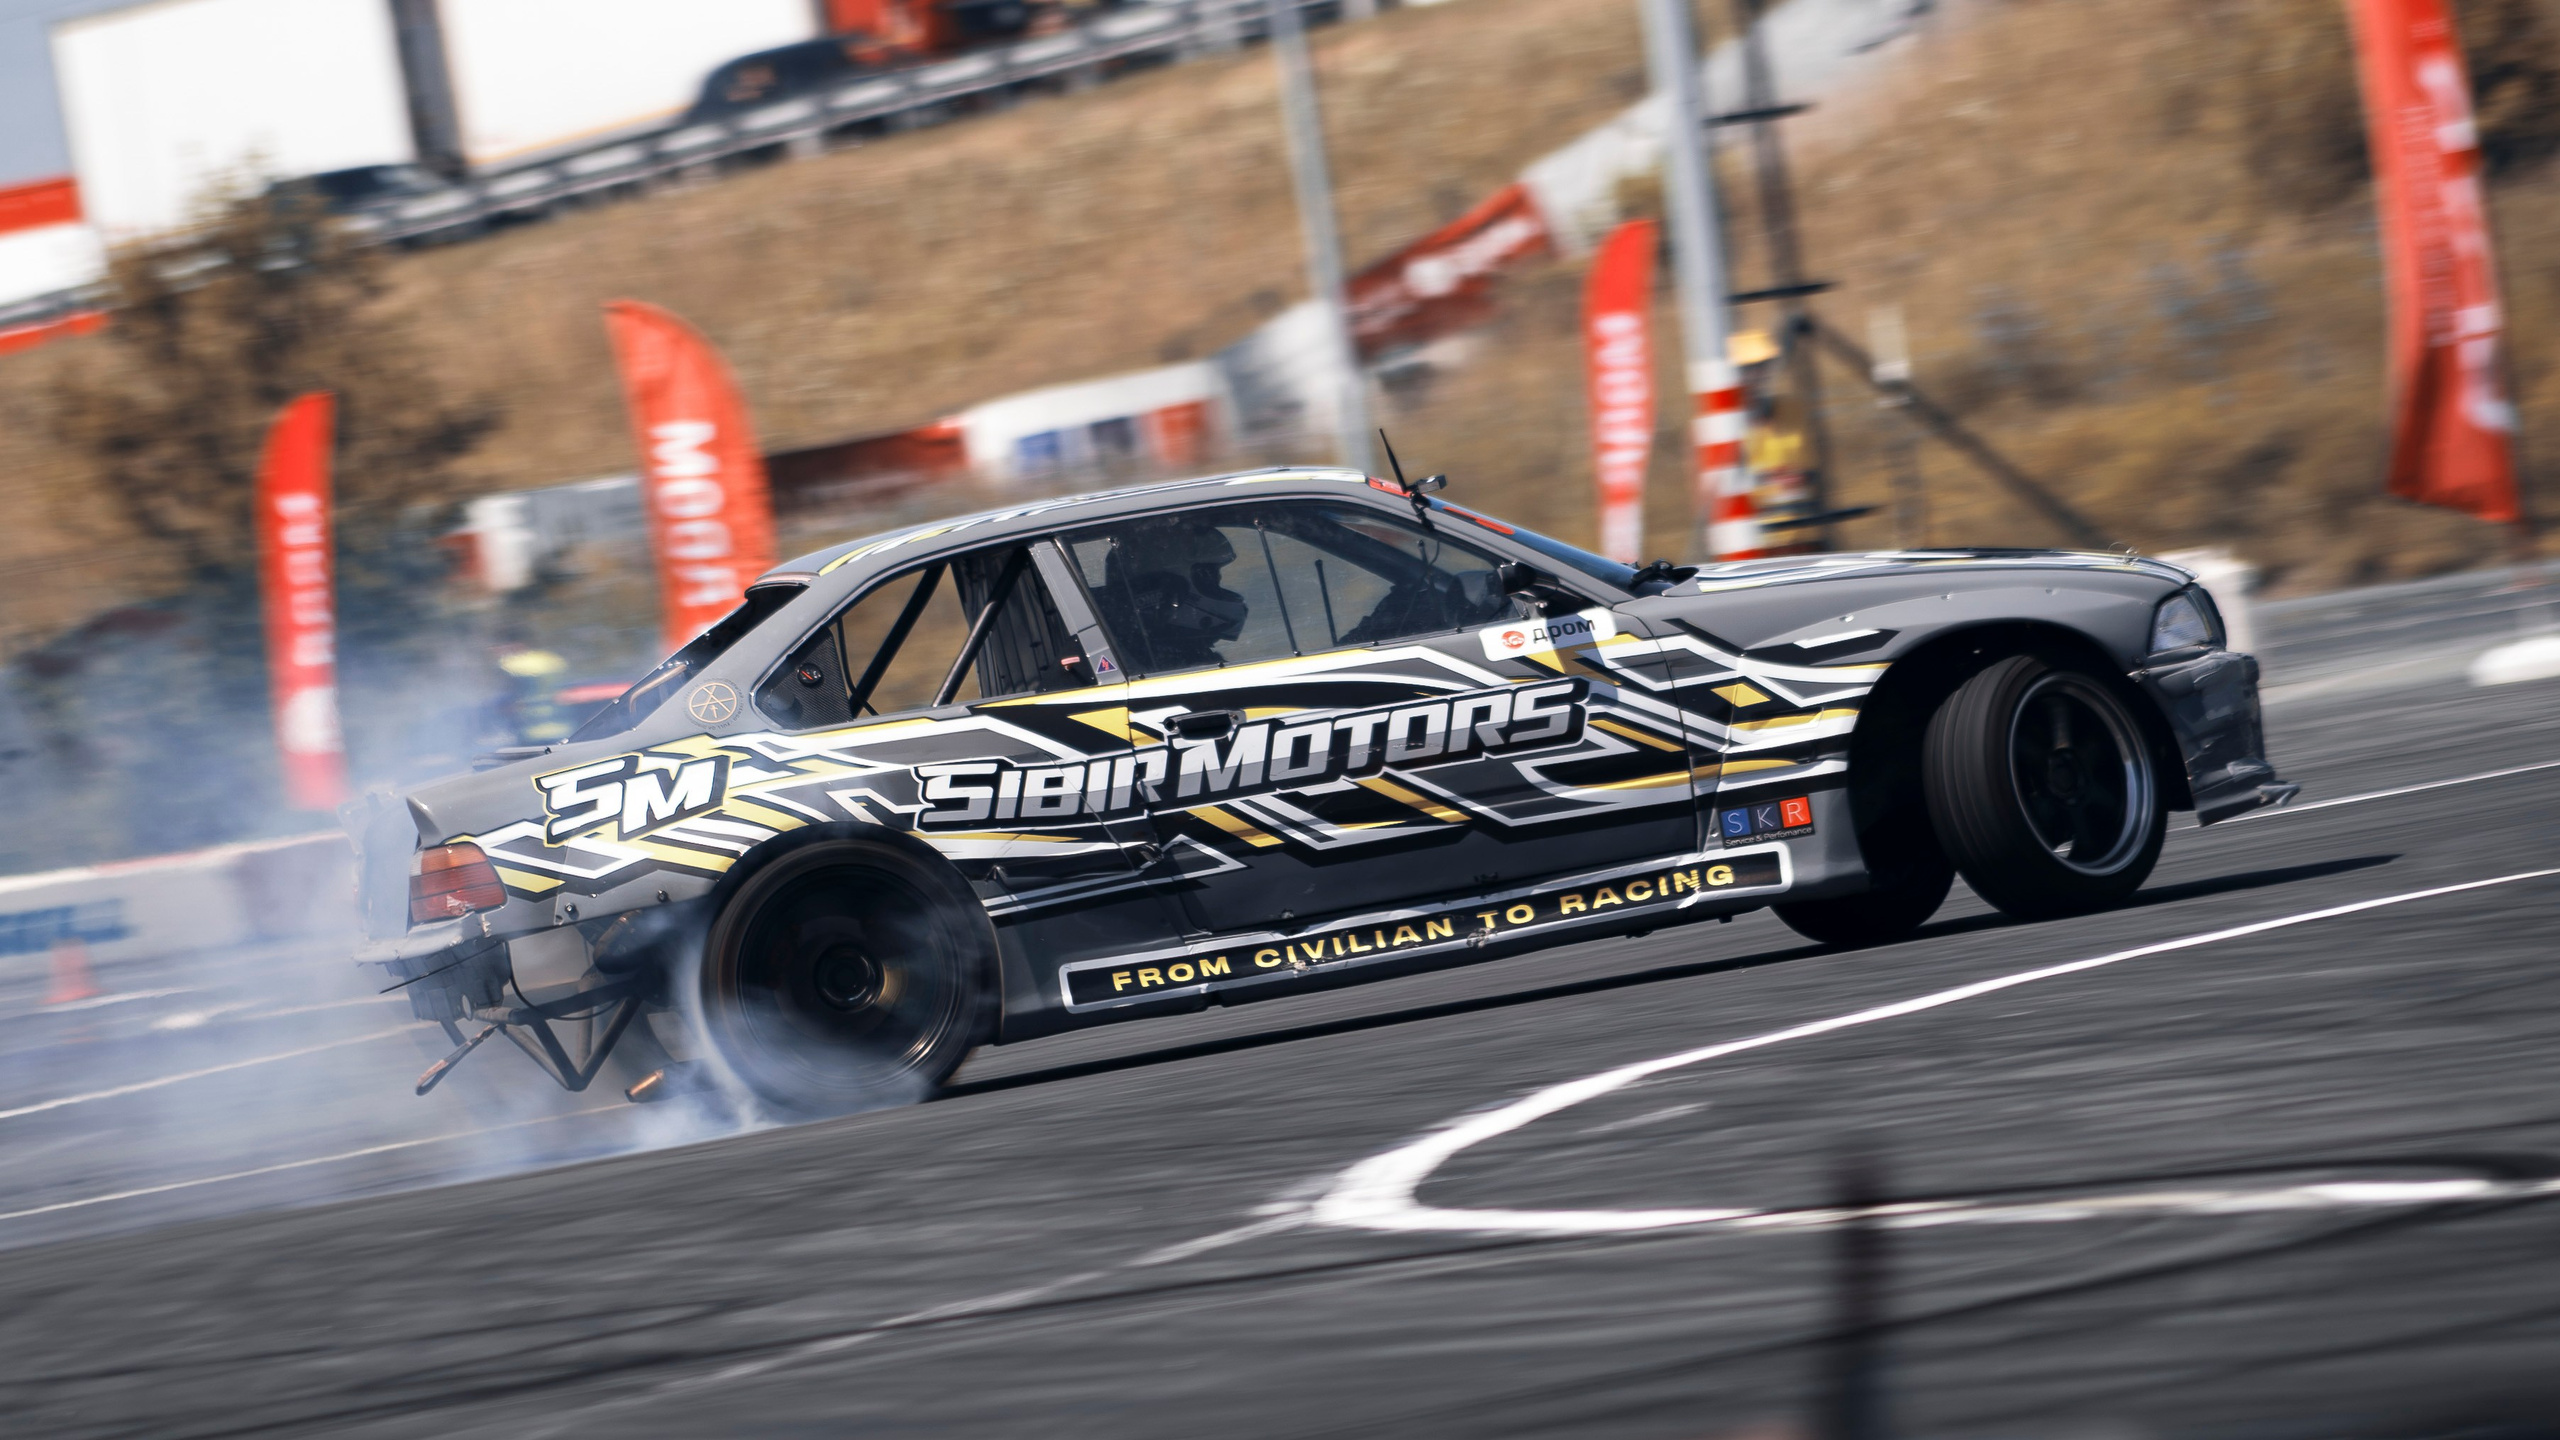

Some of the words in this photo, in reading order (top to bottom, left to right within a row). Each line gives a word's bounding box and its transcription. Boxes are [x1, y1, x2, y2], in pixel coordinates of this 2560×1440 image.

[917, 749, 1168, 823] SIBIR
[1172, 683, 1576, 799] MOTORS
[537, 757, 717, 836] SM
[1727, 802, 1805, 834] SKR
[1725, 836, 1755, 847] Service
[1755, 834, 1763, 842] &
[1112, 956, 1232, 992] FROM
[1254, 918, 1455, 969] CIVILIAN
[1476, 904, 1535, 929] TO
[1559, 864, 1736, 915] RACING
